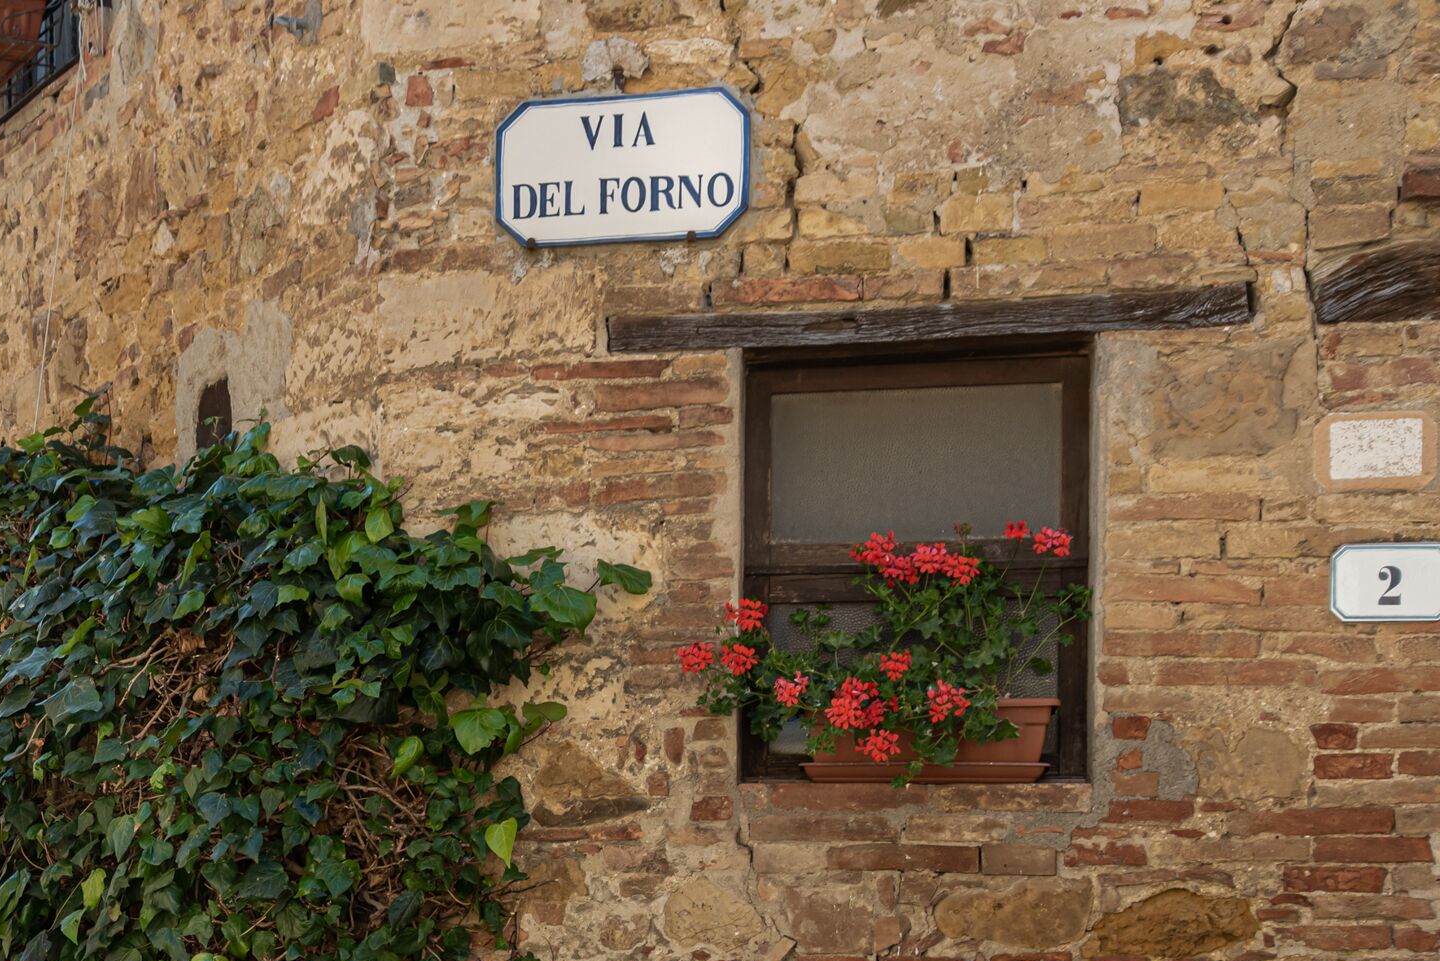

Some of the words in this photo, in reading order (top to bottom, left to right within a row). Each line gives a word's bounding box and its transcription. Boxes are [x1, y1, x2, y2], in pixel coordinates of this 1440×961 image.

[580, 111, 656, 151] VIA
[511, 180, 585, 220] DEL
[599, 172, 734, 215] FORNO
[1377, 565, 1402, 605] 2
